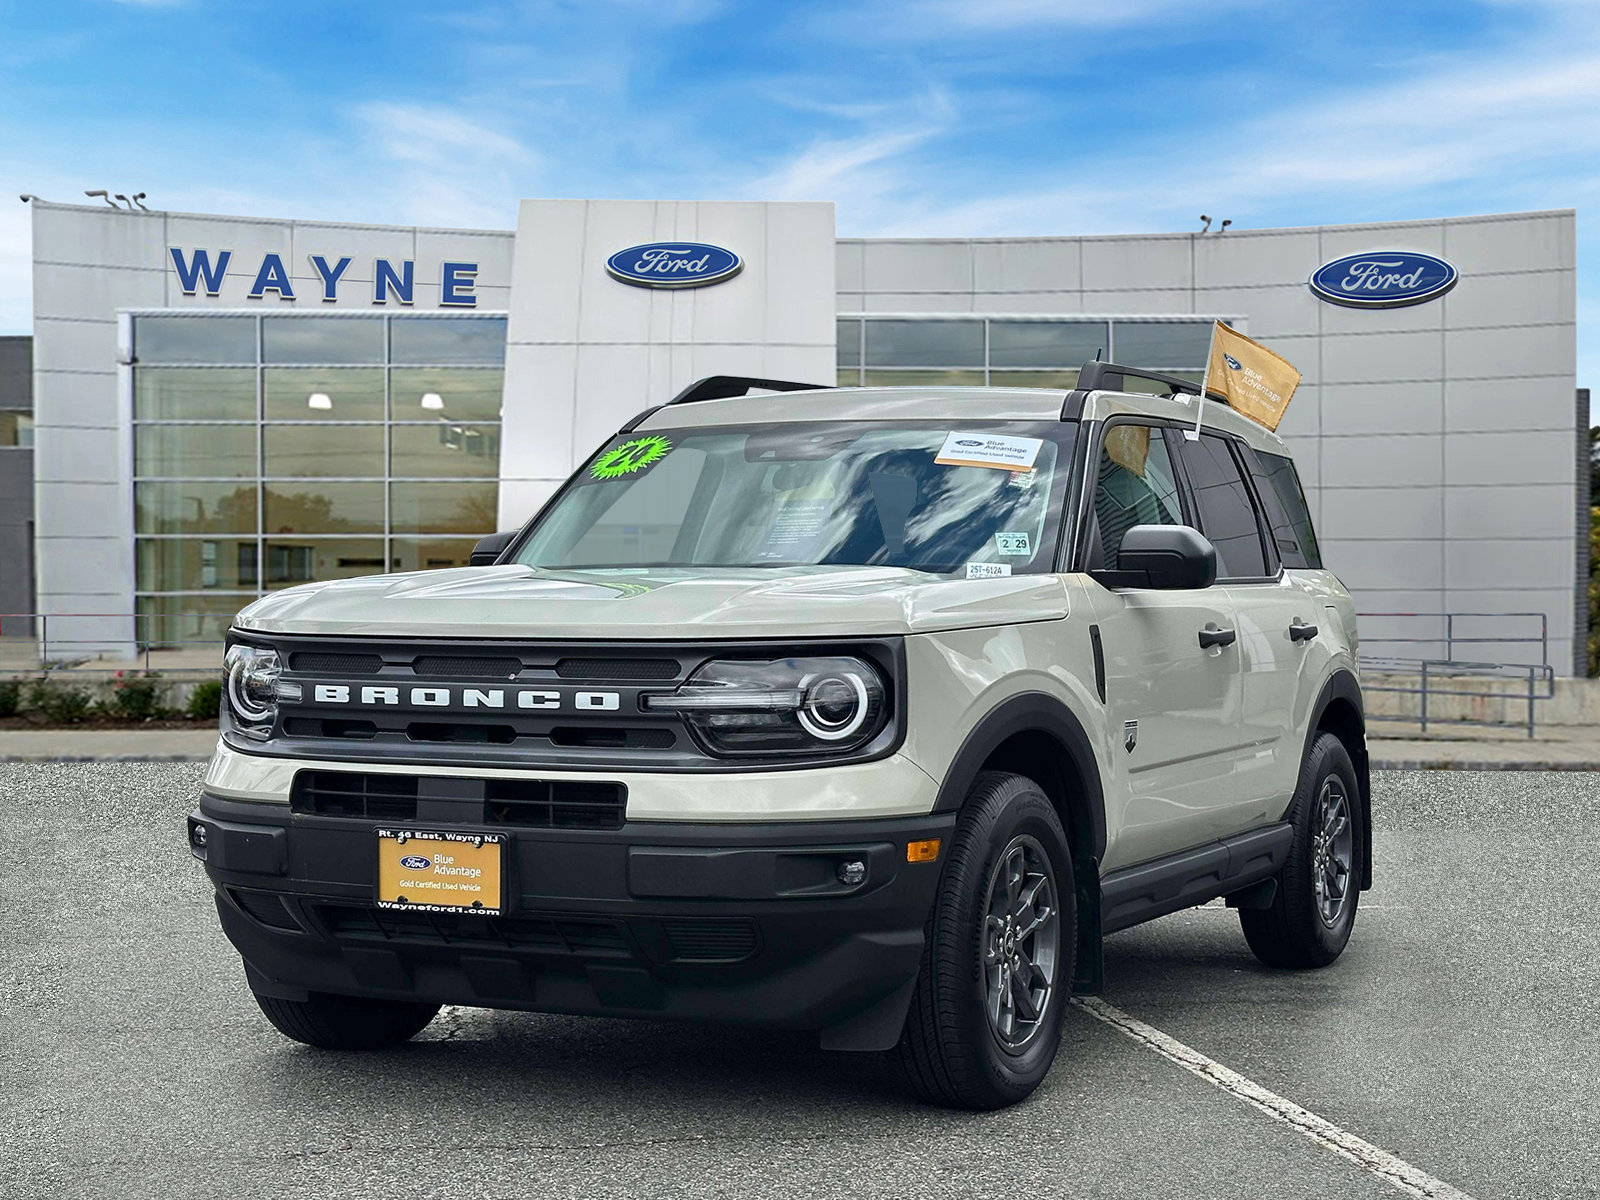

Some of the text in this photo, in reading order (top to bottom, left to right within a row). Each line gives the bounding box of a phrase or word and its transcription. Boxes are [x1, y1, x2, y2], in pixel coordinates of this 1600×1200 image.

[634, 249, 710, 273] Ford
[169, 247, 480, 307] WAYNE
[1341, 261, 1424, 291] Ford
[1244, 367, 1262, 381] Blue
[984, 445, 1027, 453] Advantage
[1002, 539, 1027, 549] 2 29
[314, 684, 620, 711] BRONCO
[415, 832, 442, 840] East,
[446, 833, 481, 843] Wayne
[485, 835, 499, 843] NJ
[405, 857, 426, 868] Ford
[434, 854, 454, 864] Blue
[434, 865, 481, 878] Advantage
[400, 880, 481, 892] Gold Certified Used Vehicle
[377, 901, 500, 916] Wayneford1.com
